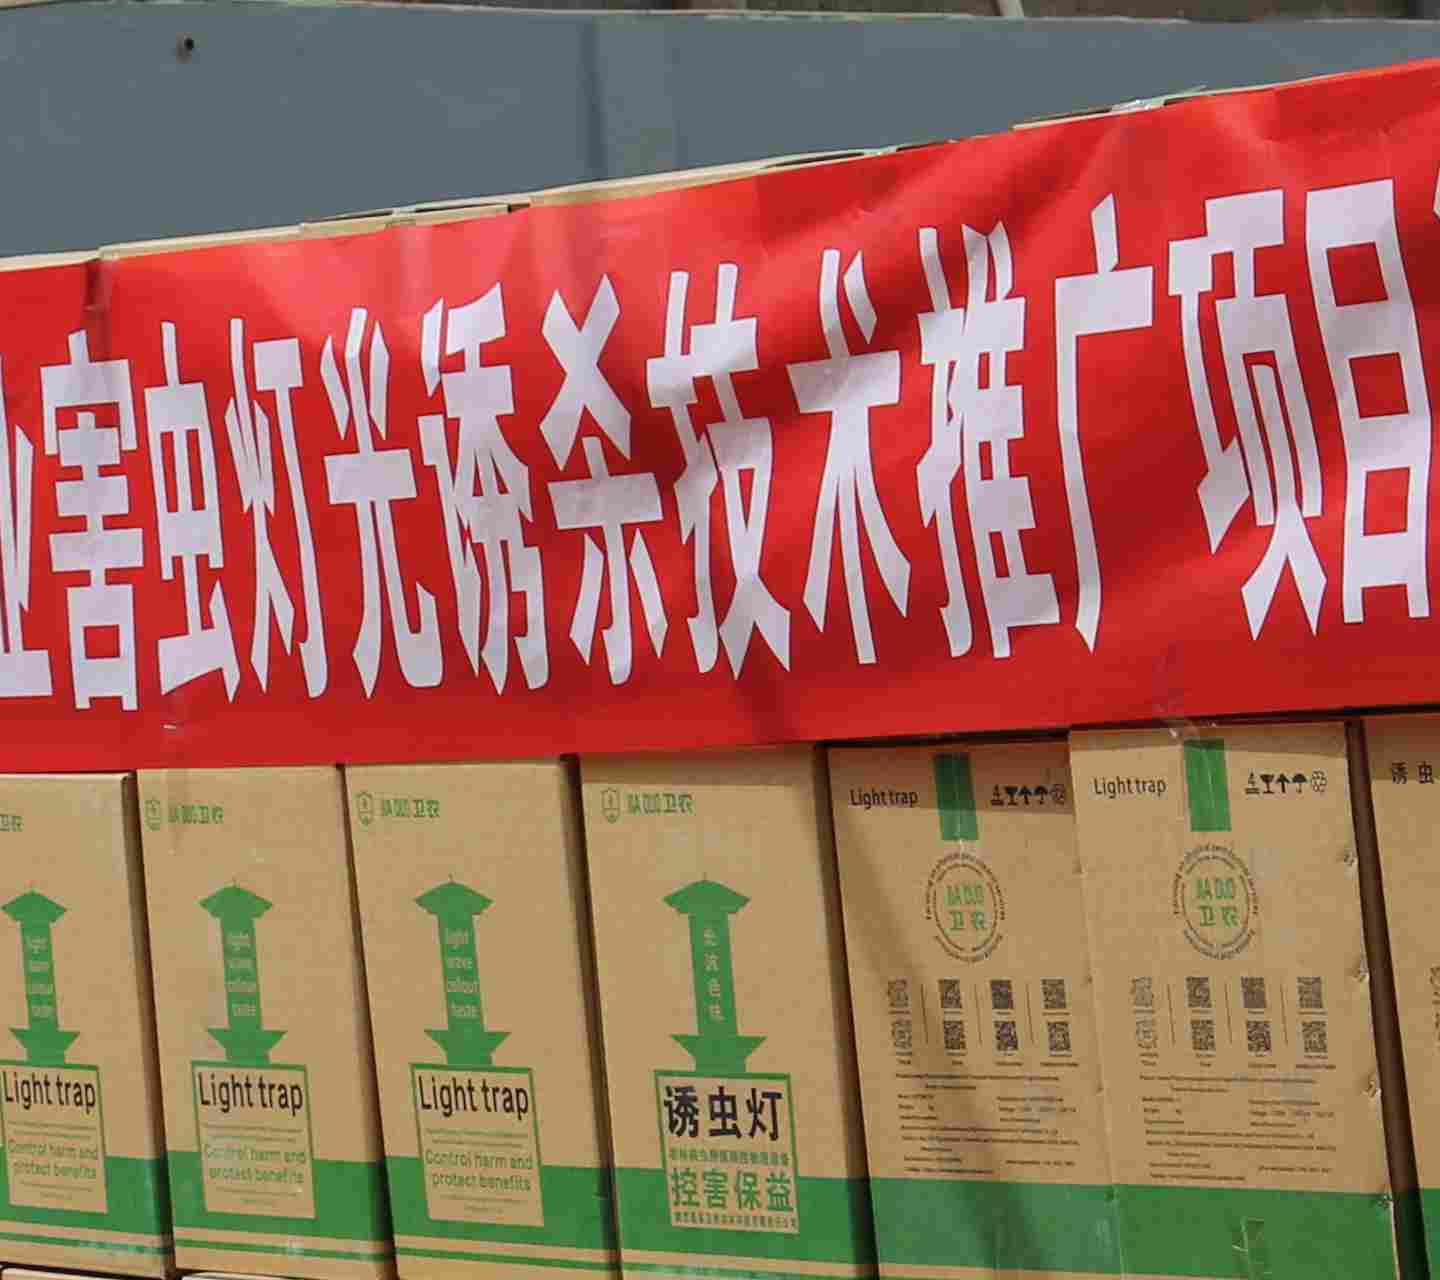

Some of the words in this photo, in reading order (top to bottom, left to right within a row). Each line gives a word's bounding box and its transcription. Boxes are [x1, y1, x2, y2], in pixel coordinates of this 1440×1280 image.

[850, 788, 887, 809] Light
[888, 789, 918, 808] trap
[1094, 776, 1134, 799] Light
[1135, 777, 1167, 797] trap
[2, 1071, 53, 1109] Light
[56, 1073, 96, 1114] trap
[198, 1072, 253, 1113] Light
[258, 1075, 303, 1116] trap
[418, 1075, 478, 1118] Light
[480, 1078, 529, 1121] trap
[664, 1086, 783, 1141] 诱虫灯
[671, 1168, 794, 1212] 控害保益
